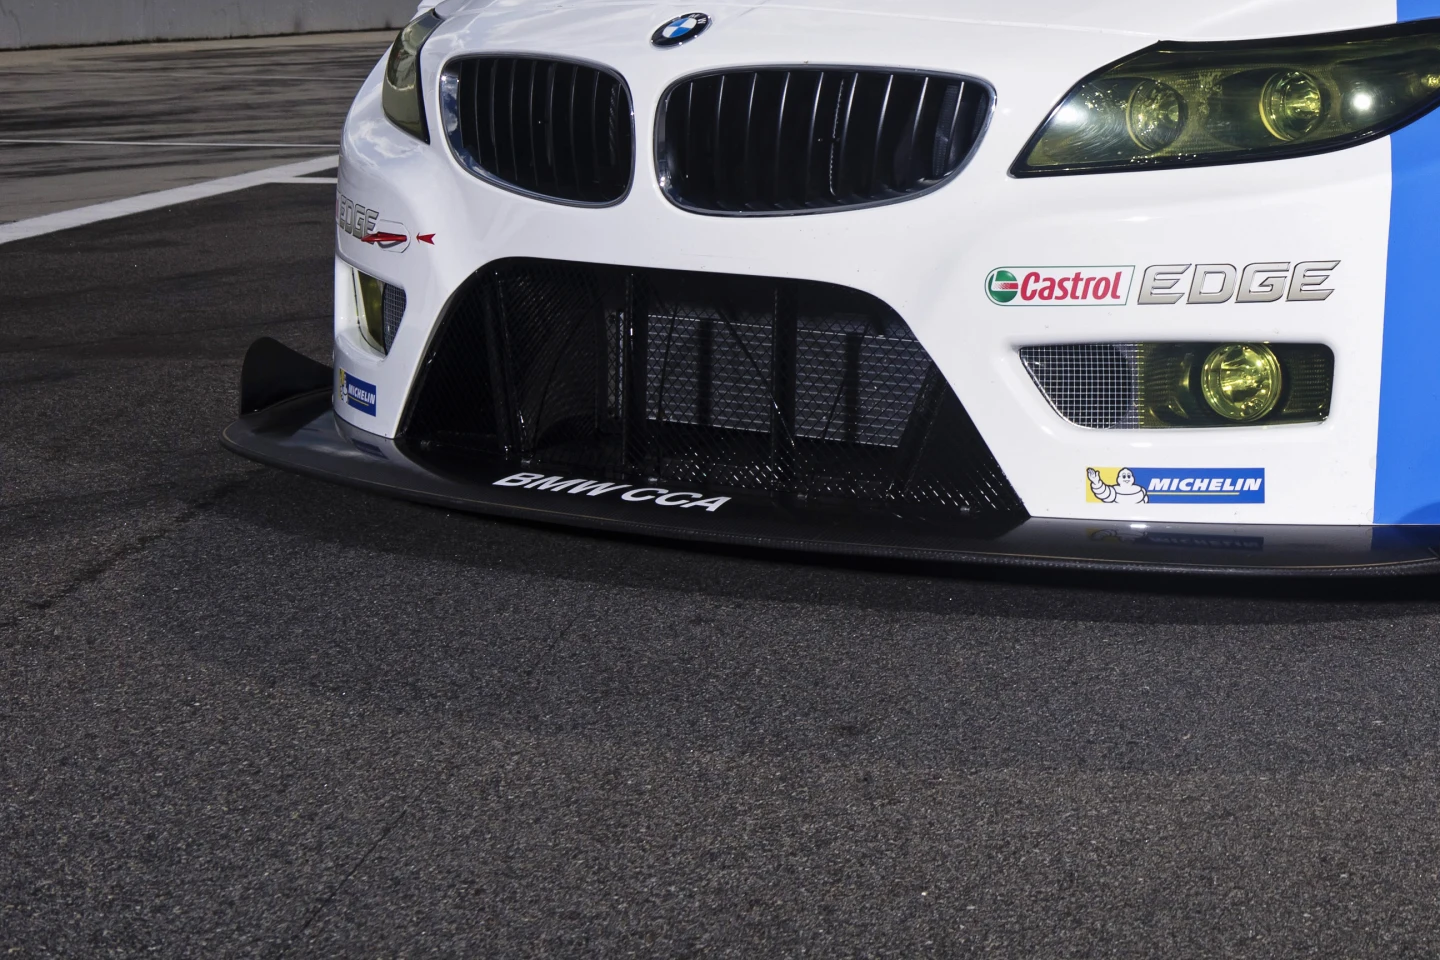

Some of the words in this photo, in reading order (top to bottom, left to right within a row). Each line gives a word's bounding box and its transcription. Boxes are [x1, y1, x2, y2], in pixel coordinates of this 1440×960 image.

[339, 194, 380, 240] EDGE
[1020, 270, 1123, 302] Castrol
[1137, 259, 1342, 306] EDGE
[348, 383, 376, 405] MICHELIN
[492, 472, 633, 496] BMW
[621, 487, 732, 512] CCA
[1147, 478, 1262, 491] MICHELIN
